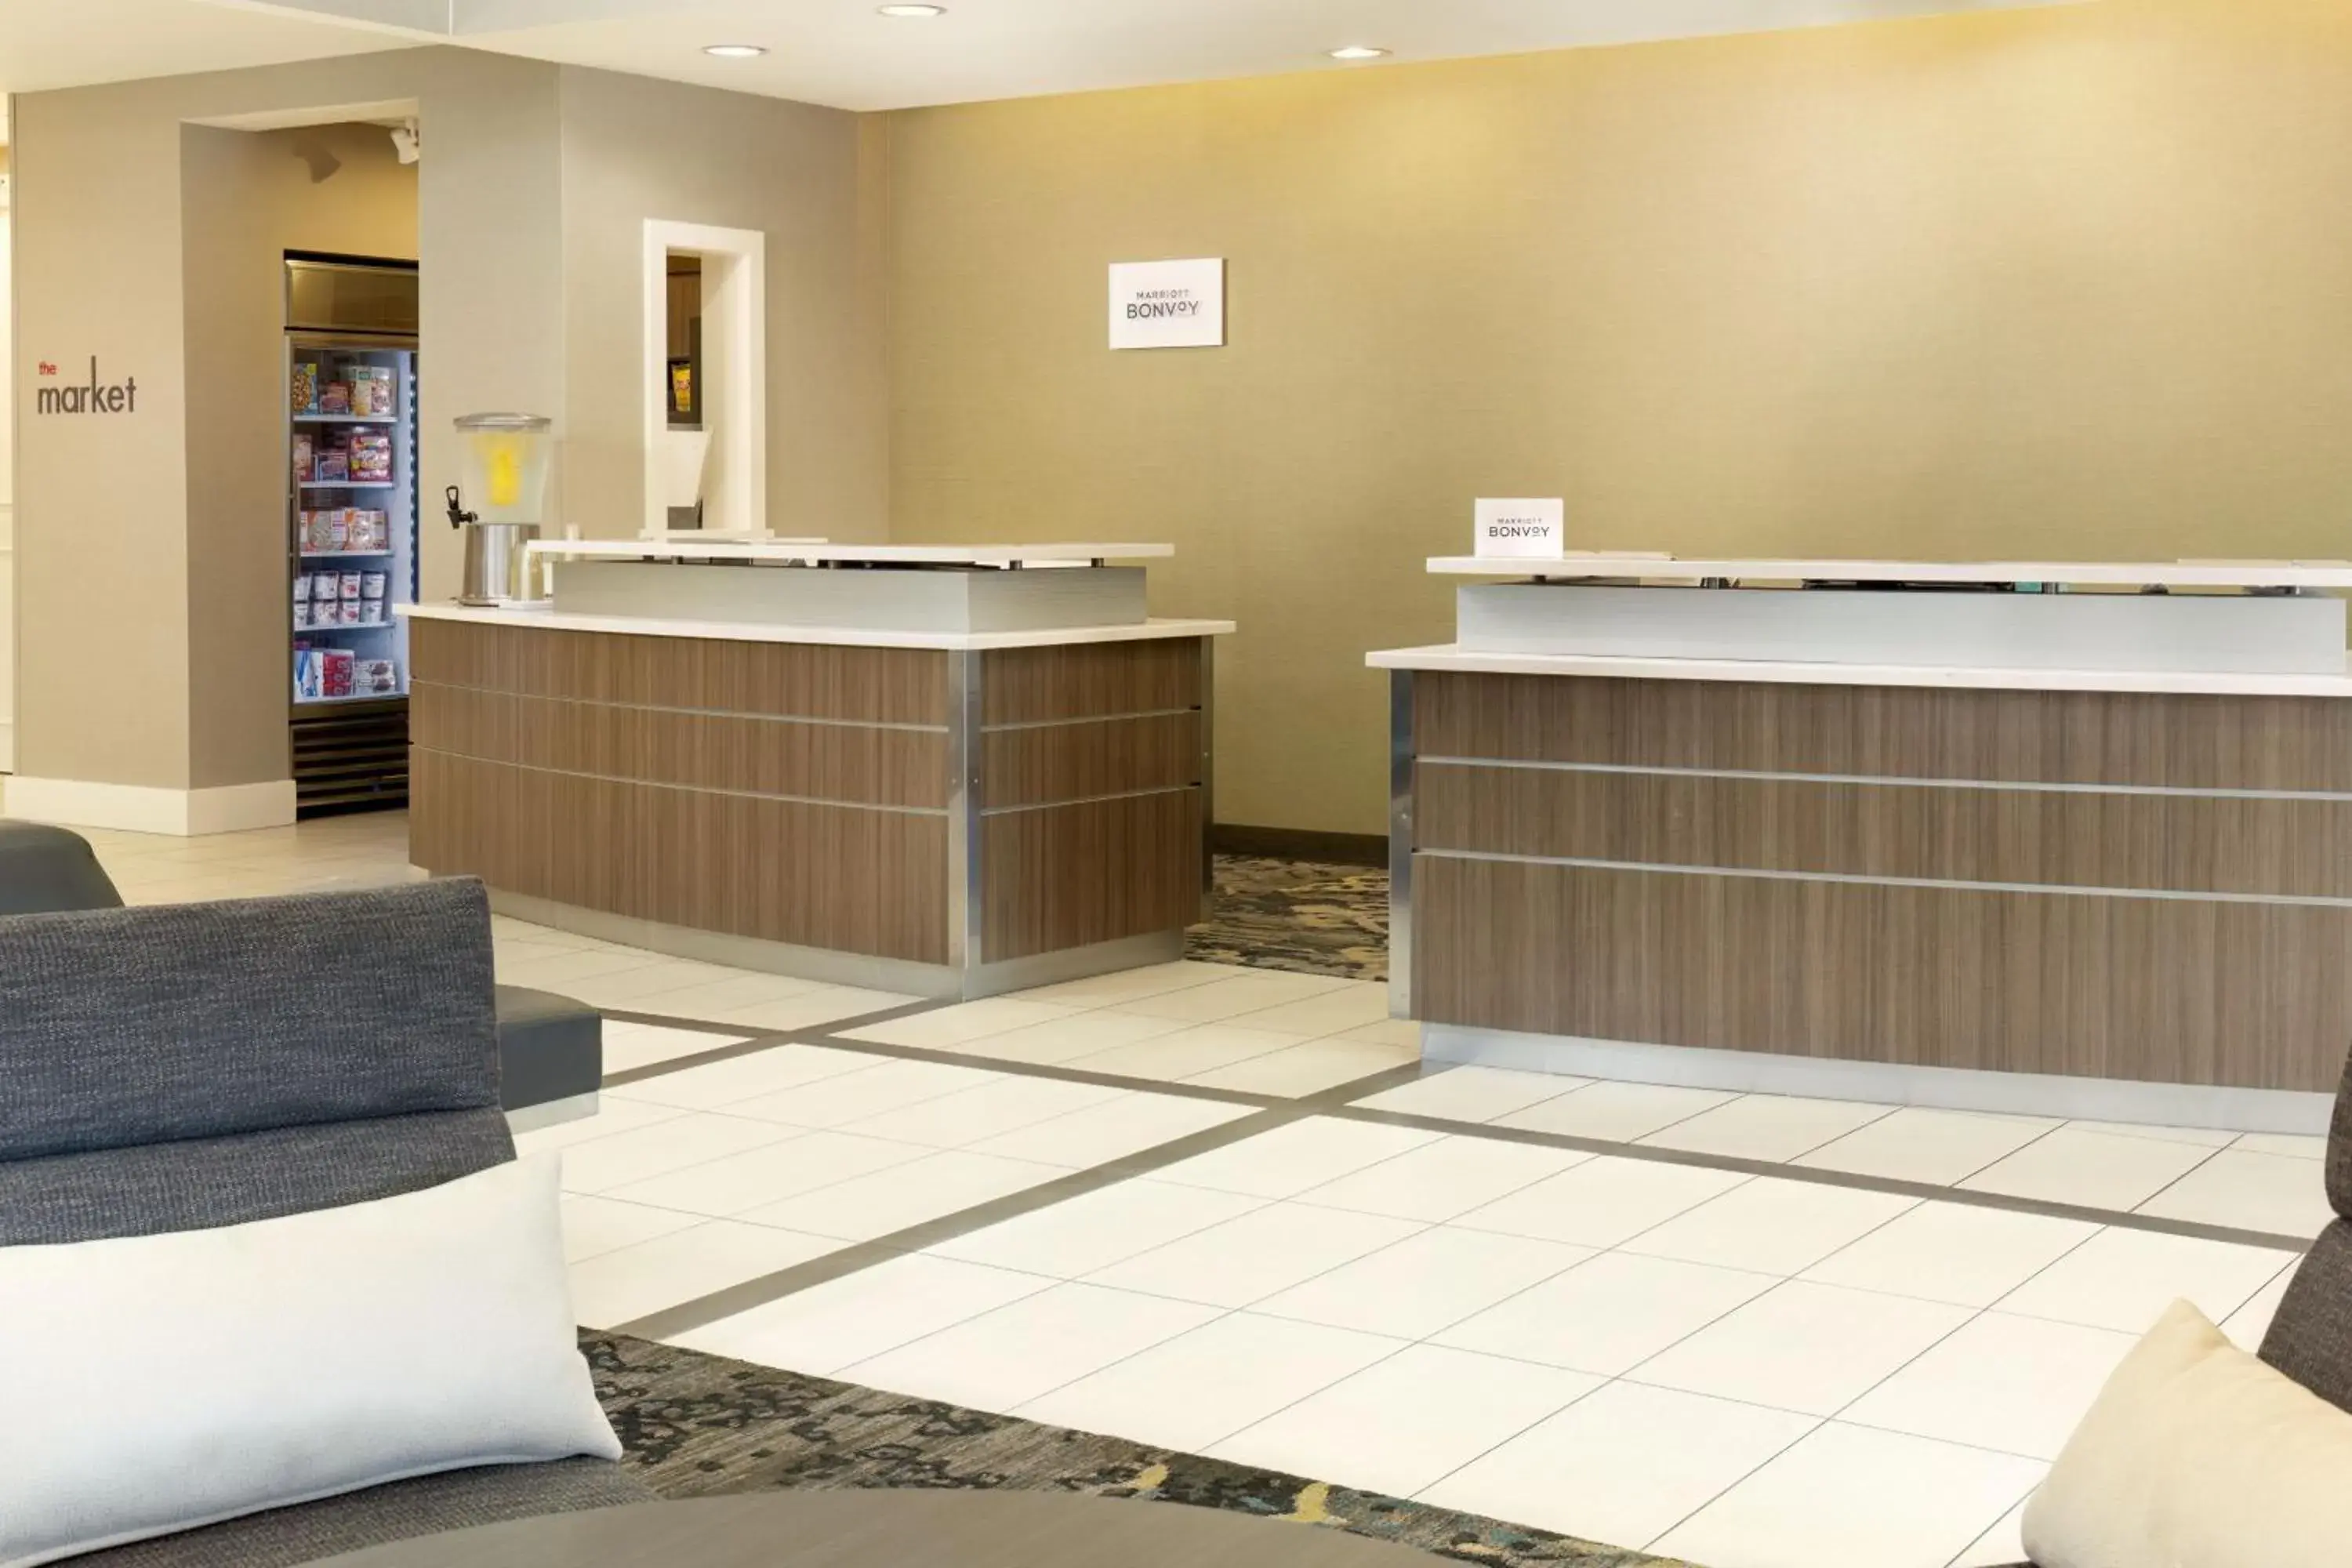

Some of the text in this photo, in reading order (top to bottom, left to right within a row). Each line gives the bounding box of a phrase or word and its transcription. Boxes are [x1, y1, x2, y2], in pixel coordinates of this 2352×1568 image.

[1136, 289, 1190, 299] MARRIOTT
[38, 361, 57, 376] the
[38, 354, 137, 414] market
